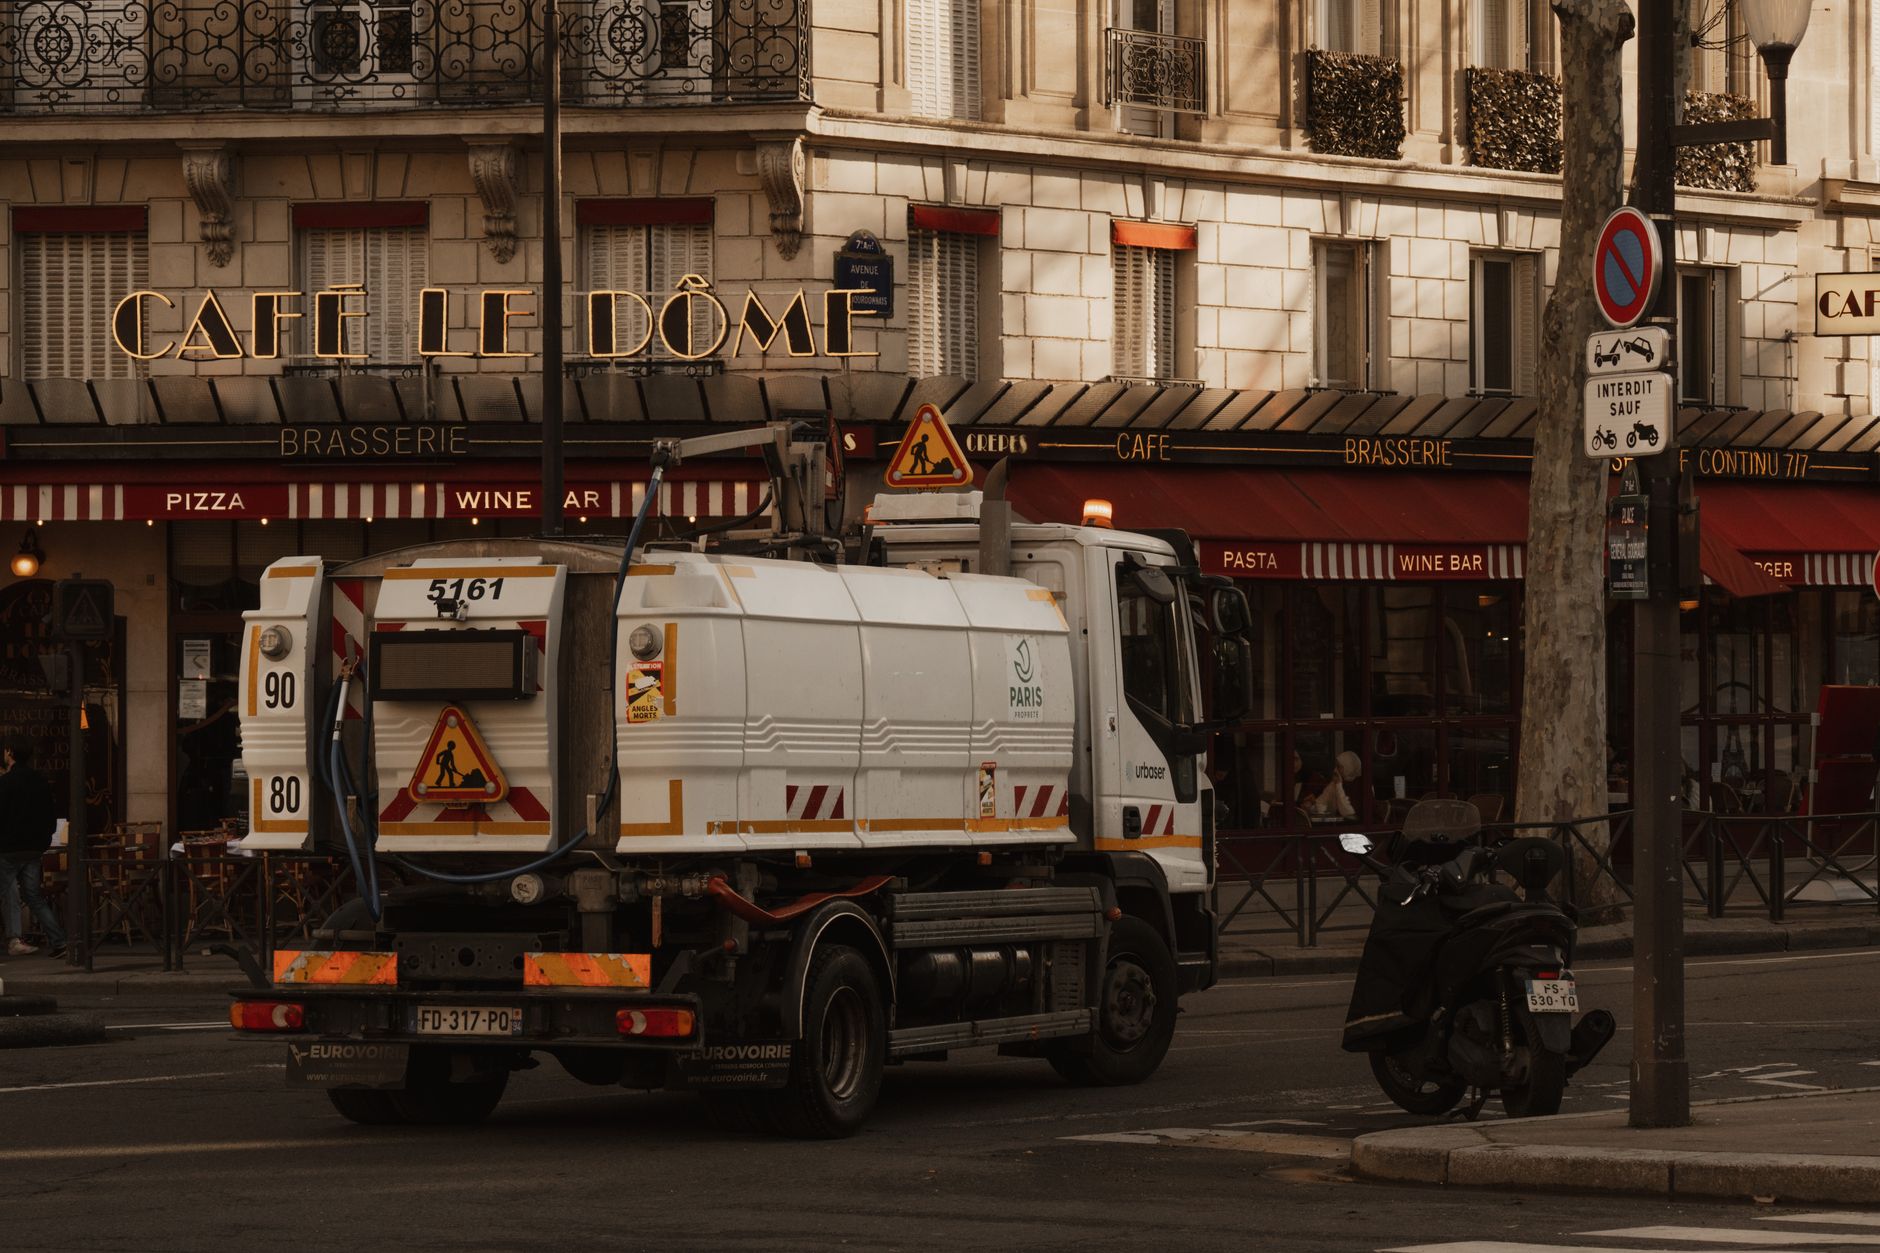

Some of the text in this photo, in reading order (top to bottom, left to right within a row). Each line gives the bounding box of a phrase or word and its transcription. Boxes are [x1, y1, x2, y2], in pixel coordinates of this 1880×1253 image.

[850, 264, 879, 275] AVENUE
[852, 295, 888, 306] OURDONNAIS
[112, 274, 881, 359] CAFÉ LE DÔME
[1597, 380, 1653, 398] INTERDIT
[1610, 400, 1641, 416] SAUF
[280, 427, 469, 456] BRASSERIE
[1345, 438, 1453, 466] BRASSERIE
[1699, 449, 1779, 477] CONTINU
[166, 492, 246, 511] PIZZA
[456, 490, 600, 509] WINE AR
[1223, 551, 1278, 569] PASTA
[1400, 555, 1483, 572] WINE BAR
[427, 578, 504, 601] 5161
[265, 671, 296, 709] 90
[1010, 686, 1042, 707] PARIS
[1135, 762, 1166, 780] urbaser
[269, 775, 300, 813] 80
[690, 1044, 792, 1060] EUROVOIRIE
